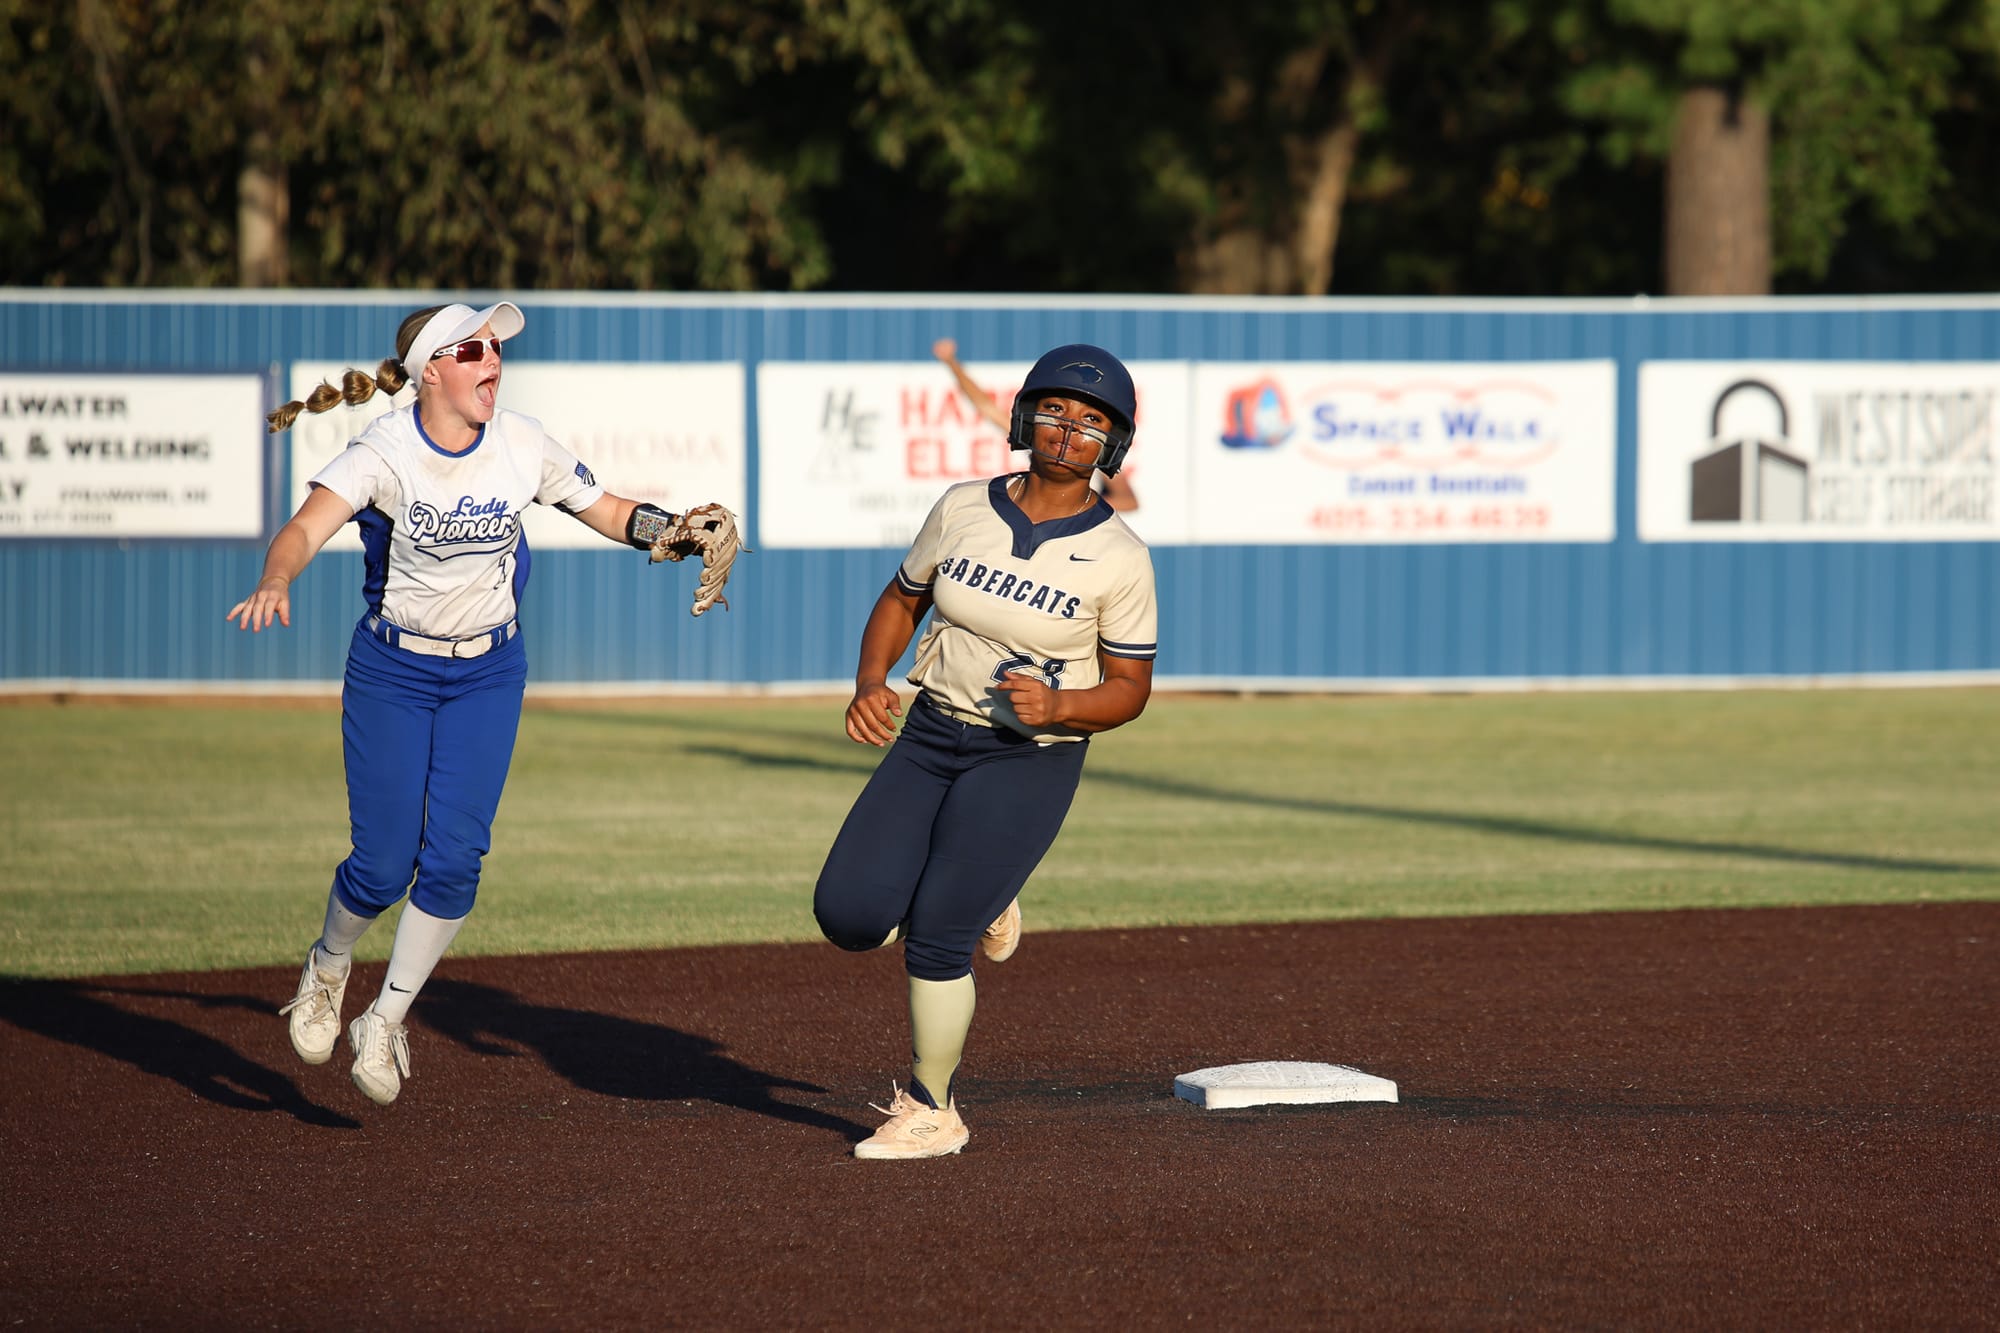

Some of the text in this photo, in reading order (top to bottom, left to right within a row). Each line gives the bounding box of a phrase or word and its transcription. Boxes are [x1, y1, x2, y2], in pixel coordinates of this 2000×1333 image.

[27, 432, 51, 460] &
[64, 437, 211, 460] WELDING
[449, 495, 509, 518] Lady
[940, 556, 1081, 619] SABERCATS
